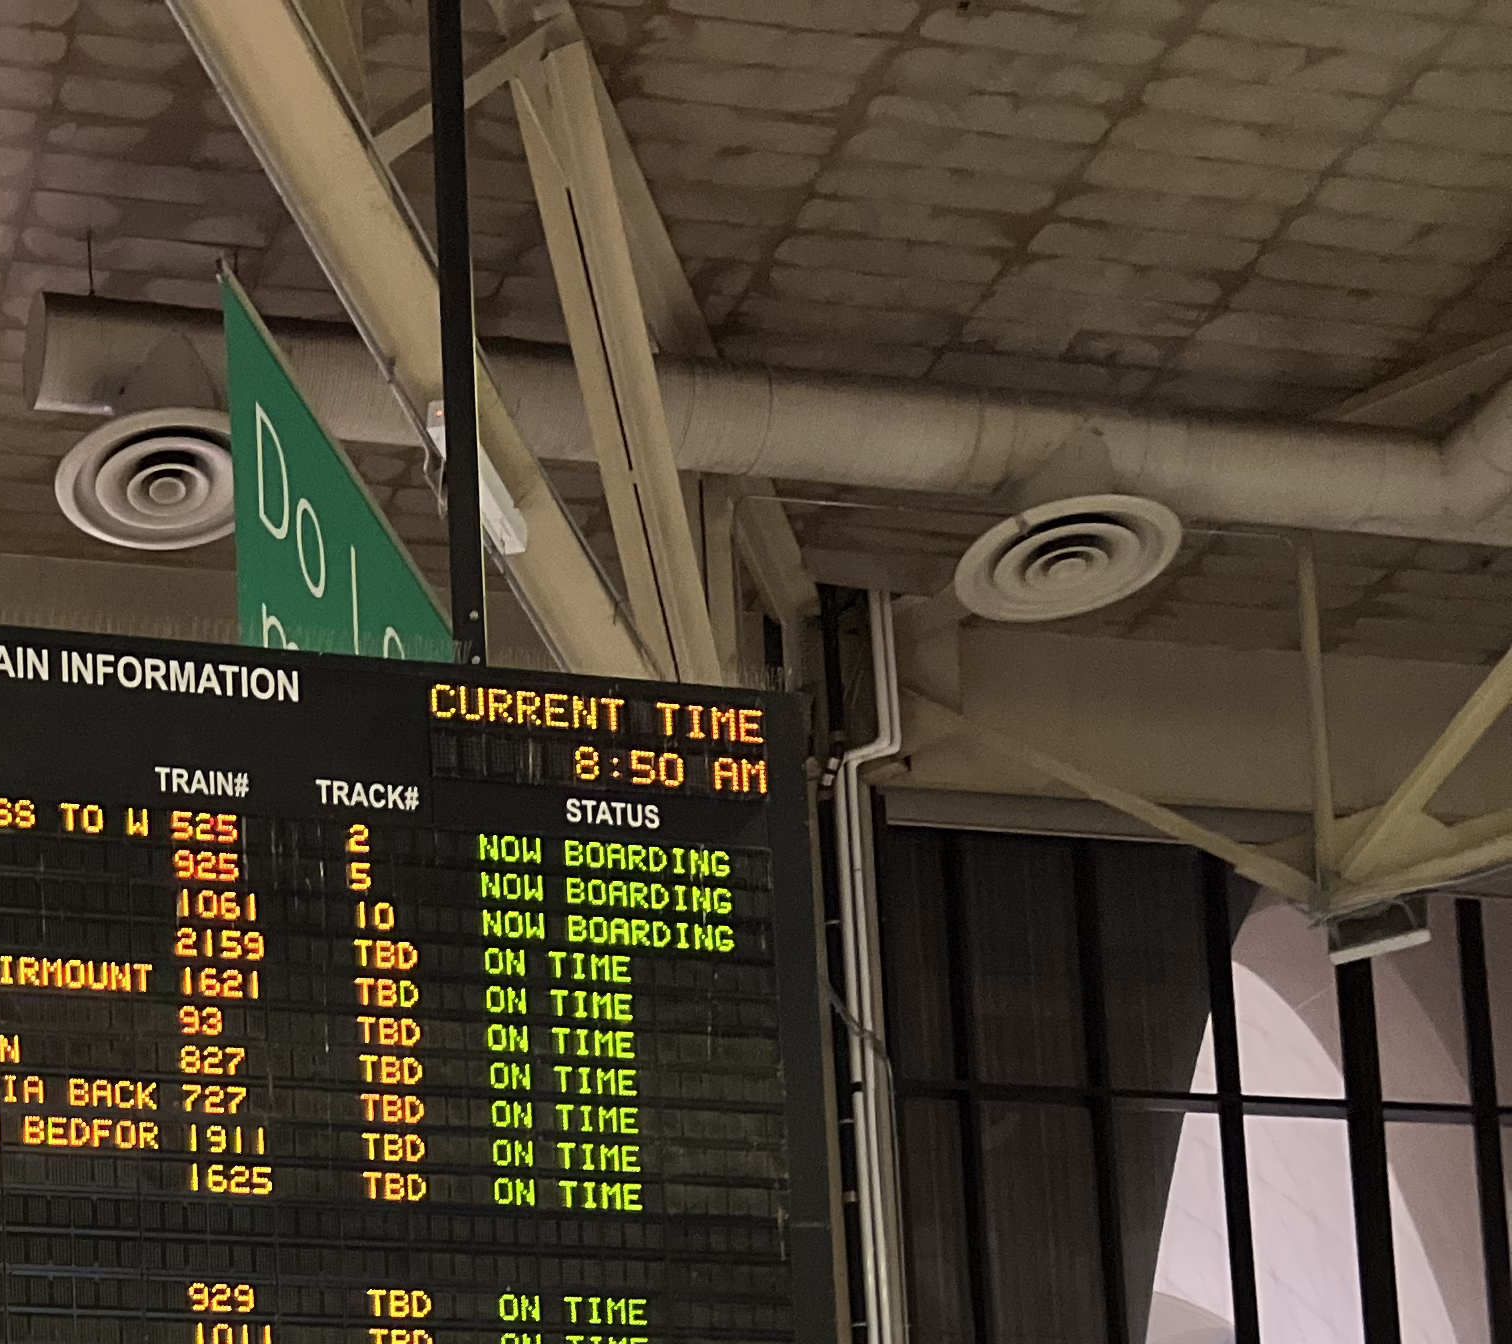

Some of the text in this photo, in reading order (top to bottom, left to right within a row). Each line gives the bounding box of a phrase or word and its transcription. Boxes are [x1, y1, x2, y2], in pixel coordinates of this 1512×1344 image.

[61, 650, 299, 703] INFORMATION
[431, 684, 765, 745] CURRENT TIME
[154, 766, 250, 799] TRAIN#
[315, 778, 420, 812] TRACK#
[566, 798, 660, 829] STATUS
[575, 746, 768, 795] 8:50 AM
[60, 804, 105, 835] TO
[127, 808, 150, 838] W
[171, 811, 239, 844] 525
[345, 824, 371, 854] 2
[479, 834, 543, 865] NOW
[564, 840, 731, 878] BOARDING
[173, 850, 241, 883] 925
[349, 862, 373, 892] 5
[480, 872, 545, 903] NOW
[566, 878, 733, 915] BOARDING
[177, 890, 258, 922] 1061
[357, 902, 396, 932] 10
[482, 910, 546, 941] NOW
[567, 916, 736, 953] BOARDING
[174, 928, 266, 962] 2159
[353, 940, 419, 971] TBD
[484, 948, 527, 978] ON
[548, 952, 633, 984] TIME
[182, 968, 260, 1000] 1621
[354, 978, 420, 1009] TBD
[486, 986, 528, 1016] ON
[550, 990, 635, 1022] TIME
[179, 1046, 246, 1077] 827
[359, 1055, 424, 1086] TBD
[490, 1063, 532, 1092] ON
[553, 1066, 638, 1098] TIME
[22, 1116, 160, 1150] BEDFOR
[190, 1125, 266, 1156] 1911
[361, 1133, 427, 1164] TBD
[492, 1140, 535, 1168] ON
[557, 1143, 642, 1174] TIME
